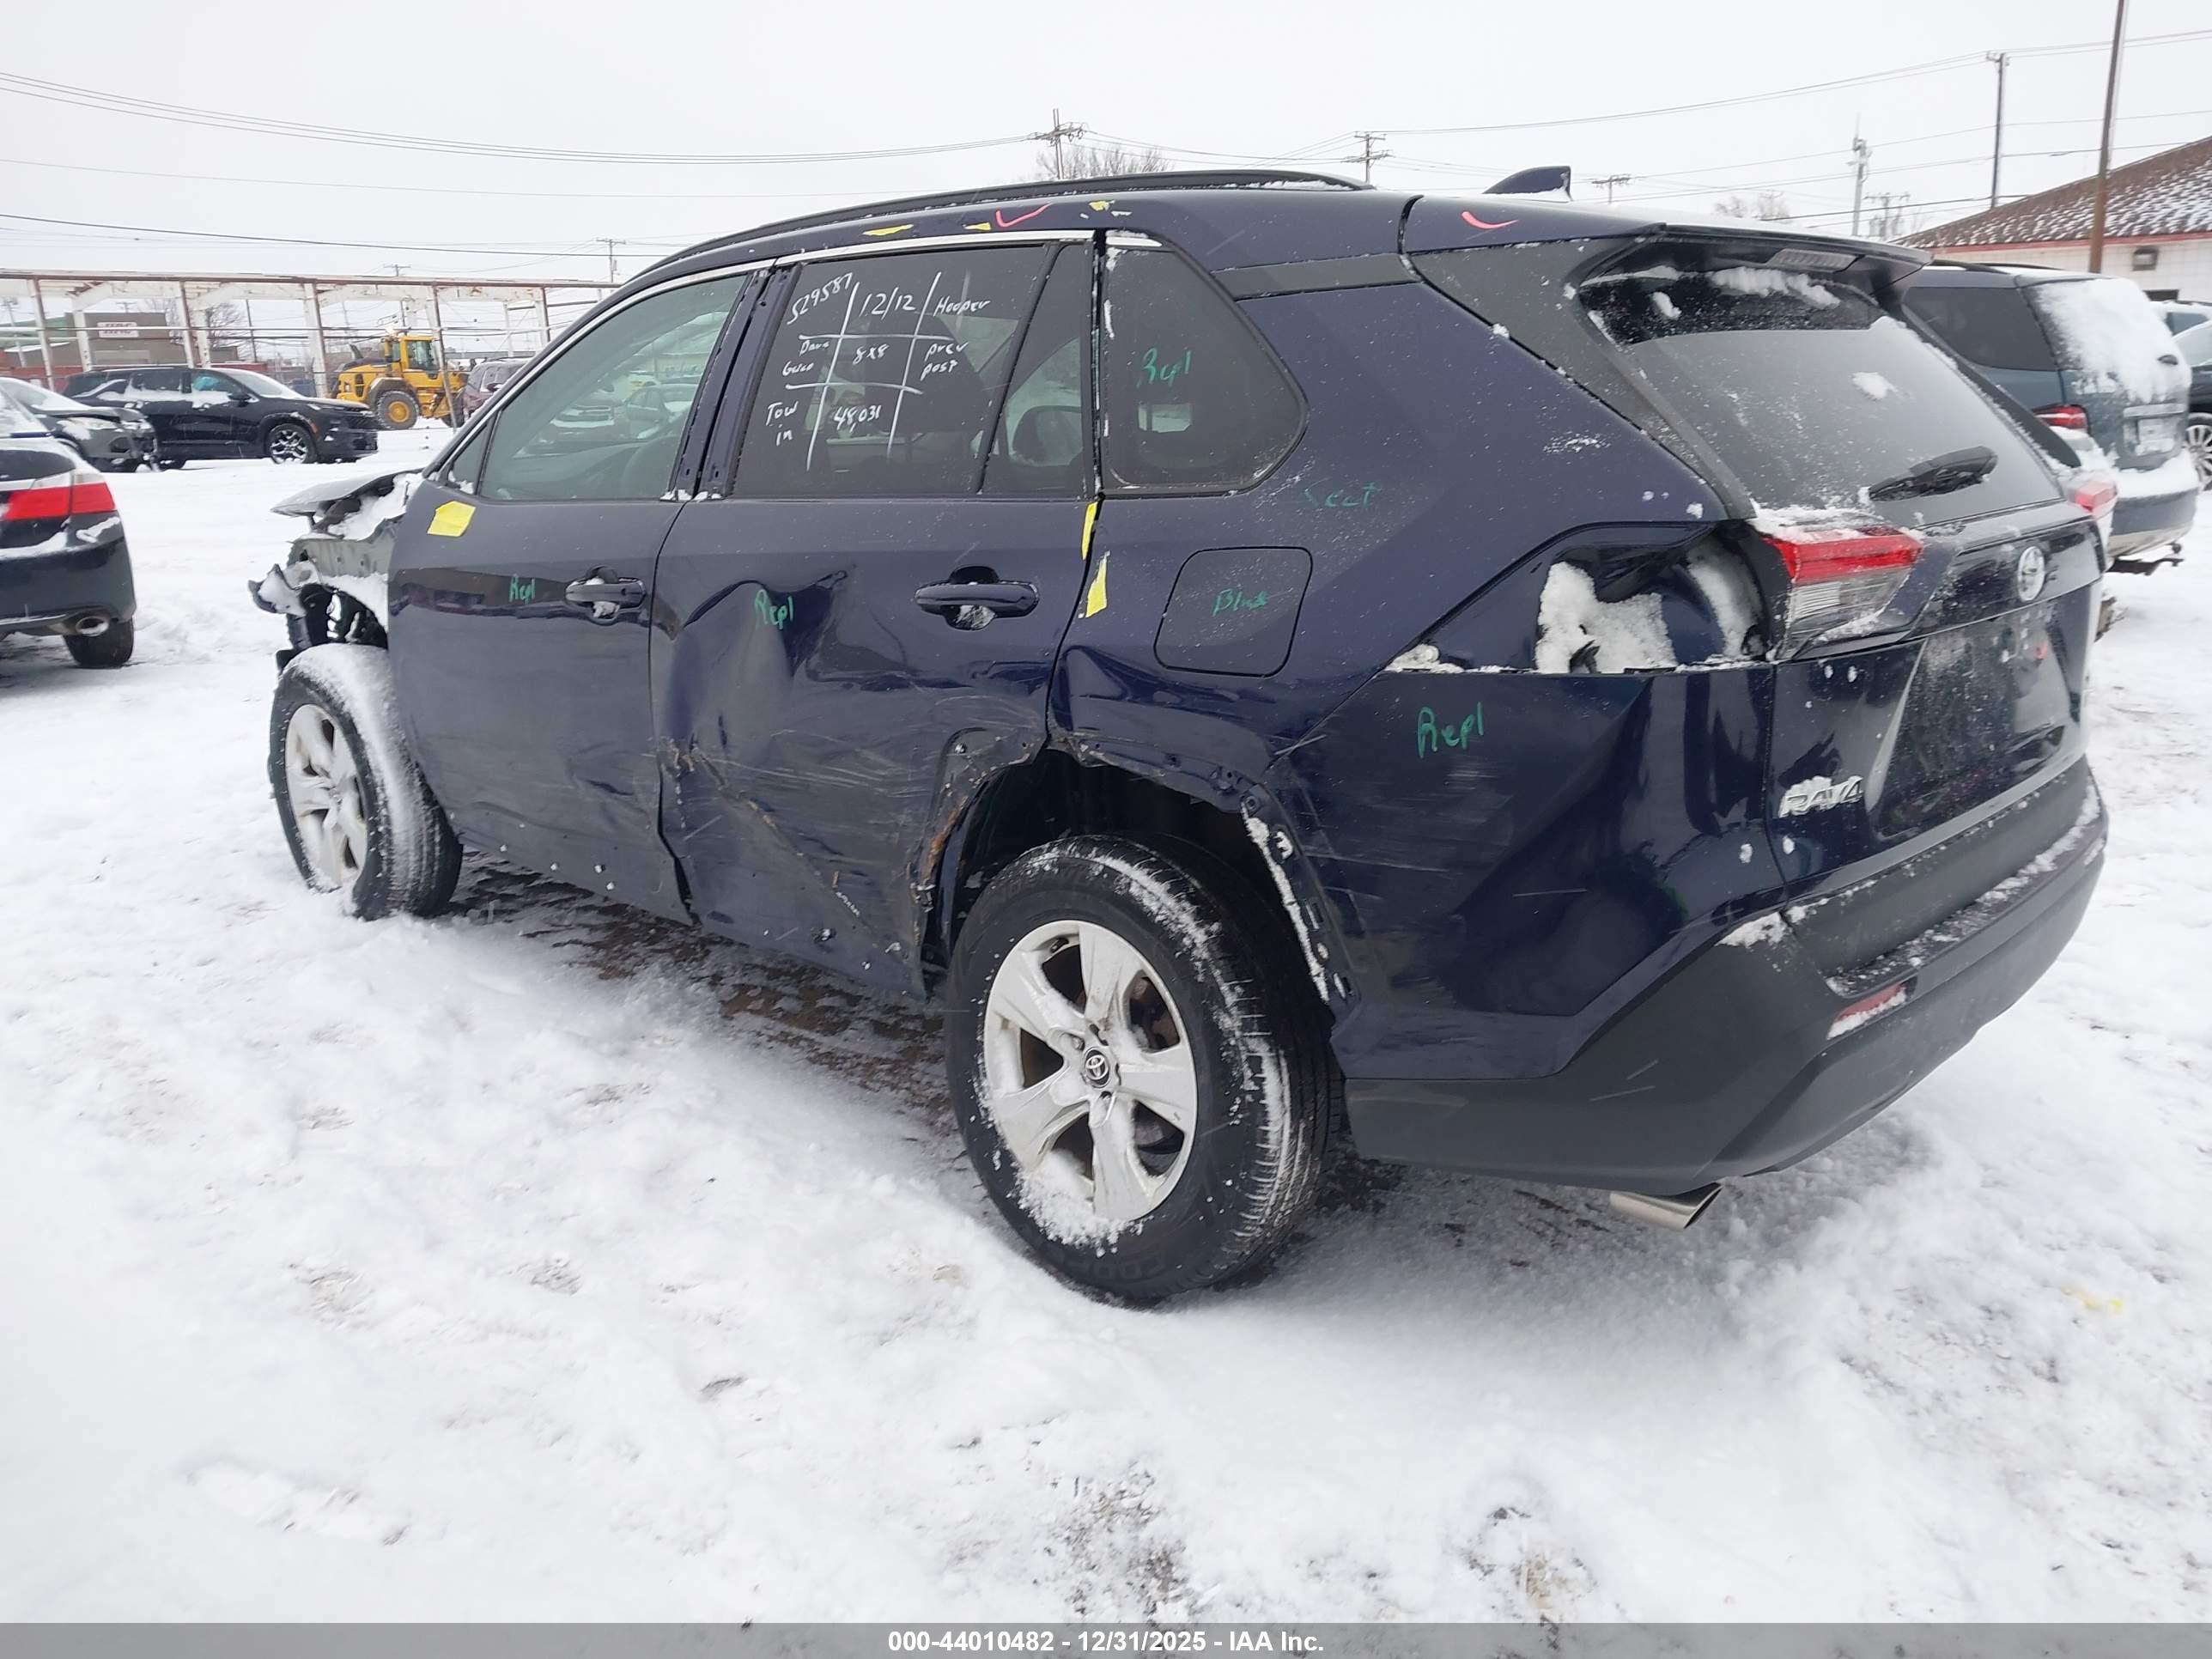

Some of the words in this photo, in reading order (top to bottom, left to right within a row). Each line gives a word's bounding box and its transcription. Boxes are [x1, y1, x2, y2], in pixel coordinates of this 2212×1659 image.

[859, 287, 917, 320] 12/12
[765, 401, 799, 426] Tow
[1417, 701, 1485, 759] Repl
[1778, 776, 1863, 818] RAV4
